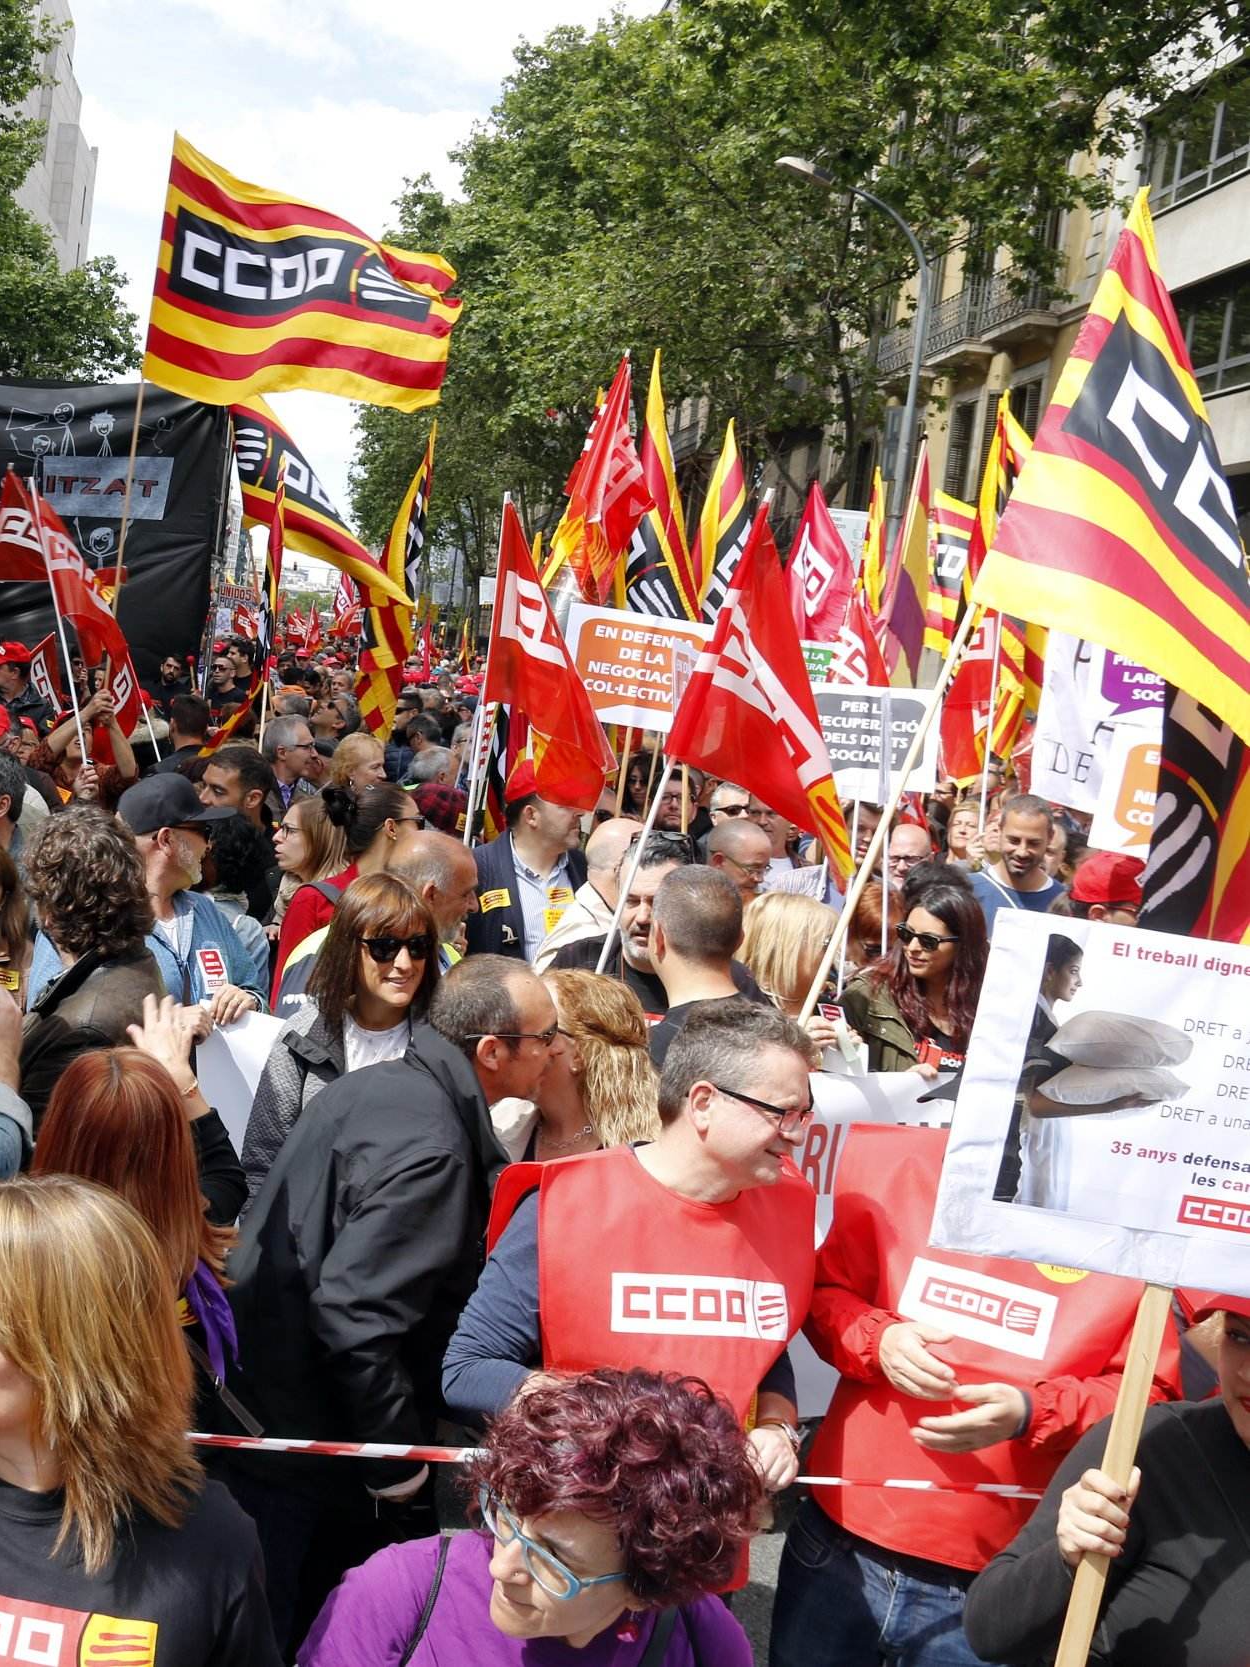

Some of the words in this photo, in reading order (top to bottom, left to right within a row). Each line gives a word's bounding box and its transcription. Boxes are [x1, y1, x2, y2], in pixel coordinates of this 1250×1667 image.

[180, 229, 346, 300] CCOO
[595, 624, 618, 640] EN
[621, 628, 694, 650] DEFENA
[619, 647, 642, 661] DE
[645, 651, 664, 666] LA
[588, 660, 672, 685] NEGOCIAC
[841, 700, 869, 713] PER
[819, 714, 919, 734] ECUPERCIÓ
[823, 731, 857, 745] DELS
[860, 735, 909, 749] DRTS
[830, 748, 897, 765] SOCIAL!
[1112, 942, 1130, 957] El
[1137, 946, 1198, 968] treball
[1183, 1018, 1229, 1037] DRET
[1232, 1028, 1242, 1039] a
[1160, 1104, 1205, 1123] DRET
[1208, 1114, 1217, 1125] a
[1223, 1117, 1250, 1130] una
[1111, 1140, 1132, 1155] 35
[1137, 1147, 1177, 1164] anys
[1191, 1172, 1216, 1187] les
[622, 1286, 745, 1322] CCOO
[925, 1282, 1001, 1317] CCOO
